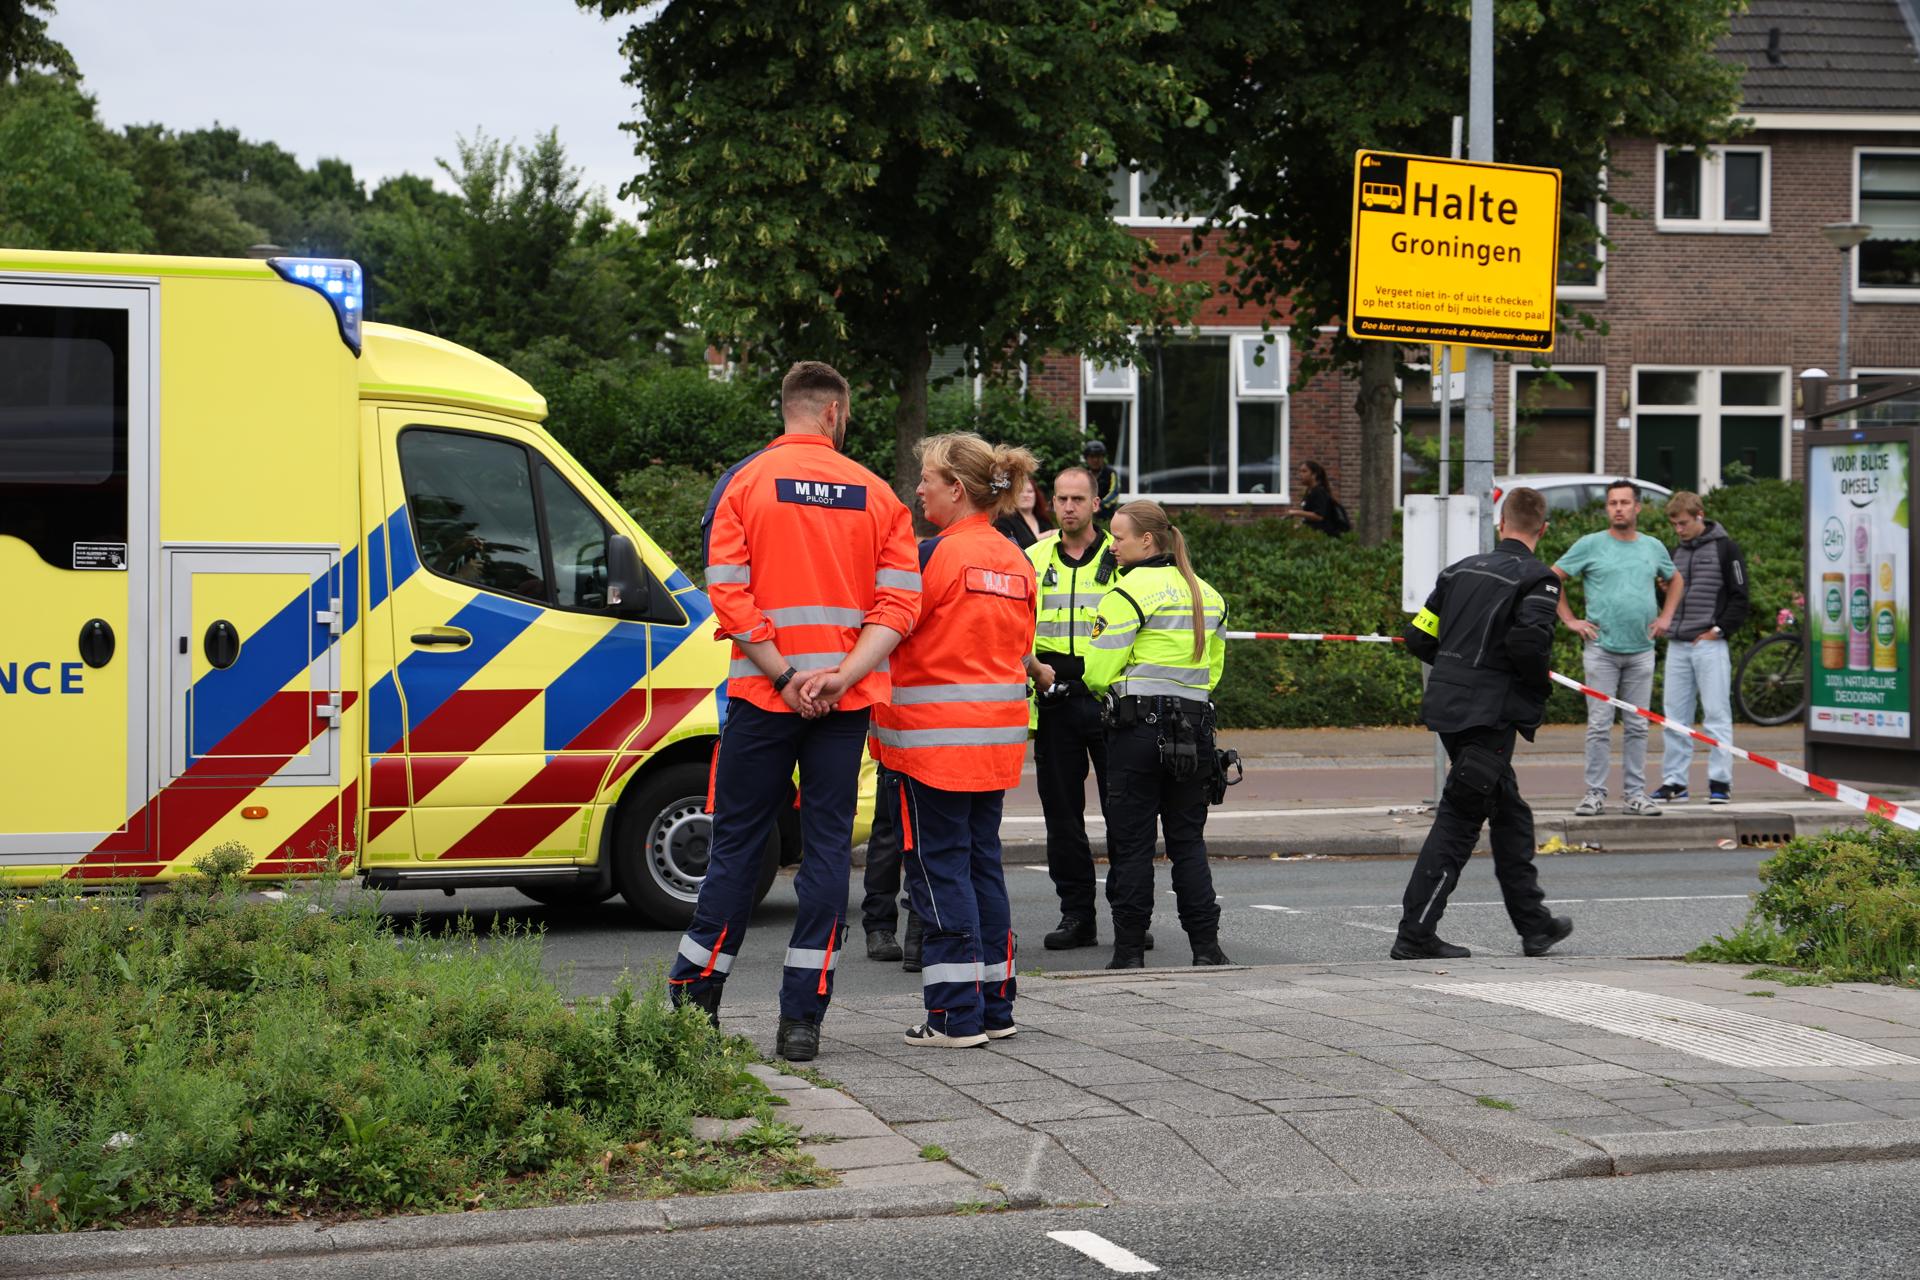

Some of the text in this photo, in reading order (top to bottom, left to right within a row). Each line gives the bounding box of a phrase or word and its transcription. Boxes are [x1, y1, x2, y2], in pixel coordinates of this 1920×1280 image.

[1413, 181, 1518, 225] Halte
[1391, 231, 1521, 266] Groningen
[1375, 285, 1534, 306] Vergeet niet in- of uit te checken
[1362, 297, 1545, 321] op het station of bij mobiele cico paal
[1361, 320, 1378, 330] Doe
[1379, 321, 1396, 331] kort
[1397, 325, 1415, 333] voor
[1416, 326, 1430, 334] uw
[1430, 326, 1458, 336] vertrek
[1459, 328, 1470, 337] de
[1831, 452, 1889, 472] VOOR BLIJE
[794, 481, 847, 499] MMT
[806, 495, 835, 505] PILOOT
[1824, 528, 1844, 547] 24h
[1834, 689, 1886, 704] DEODORANT
